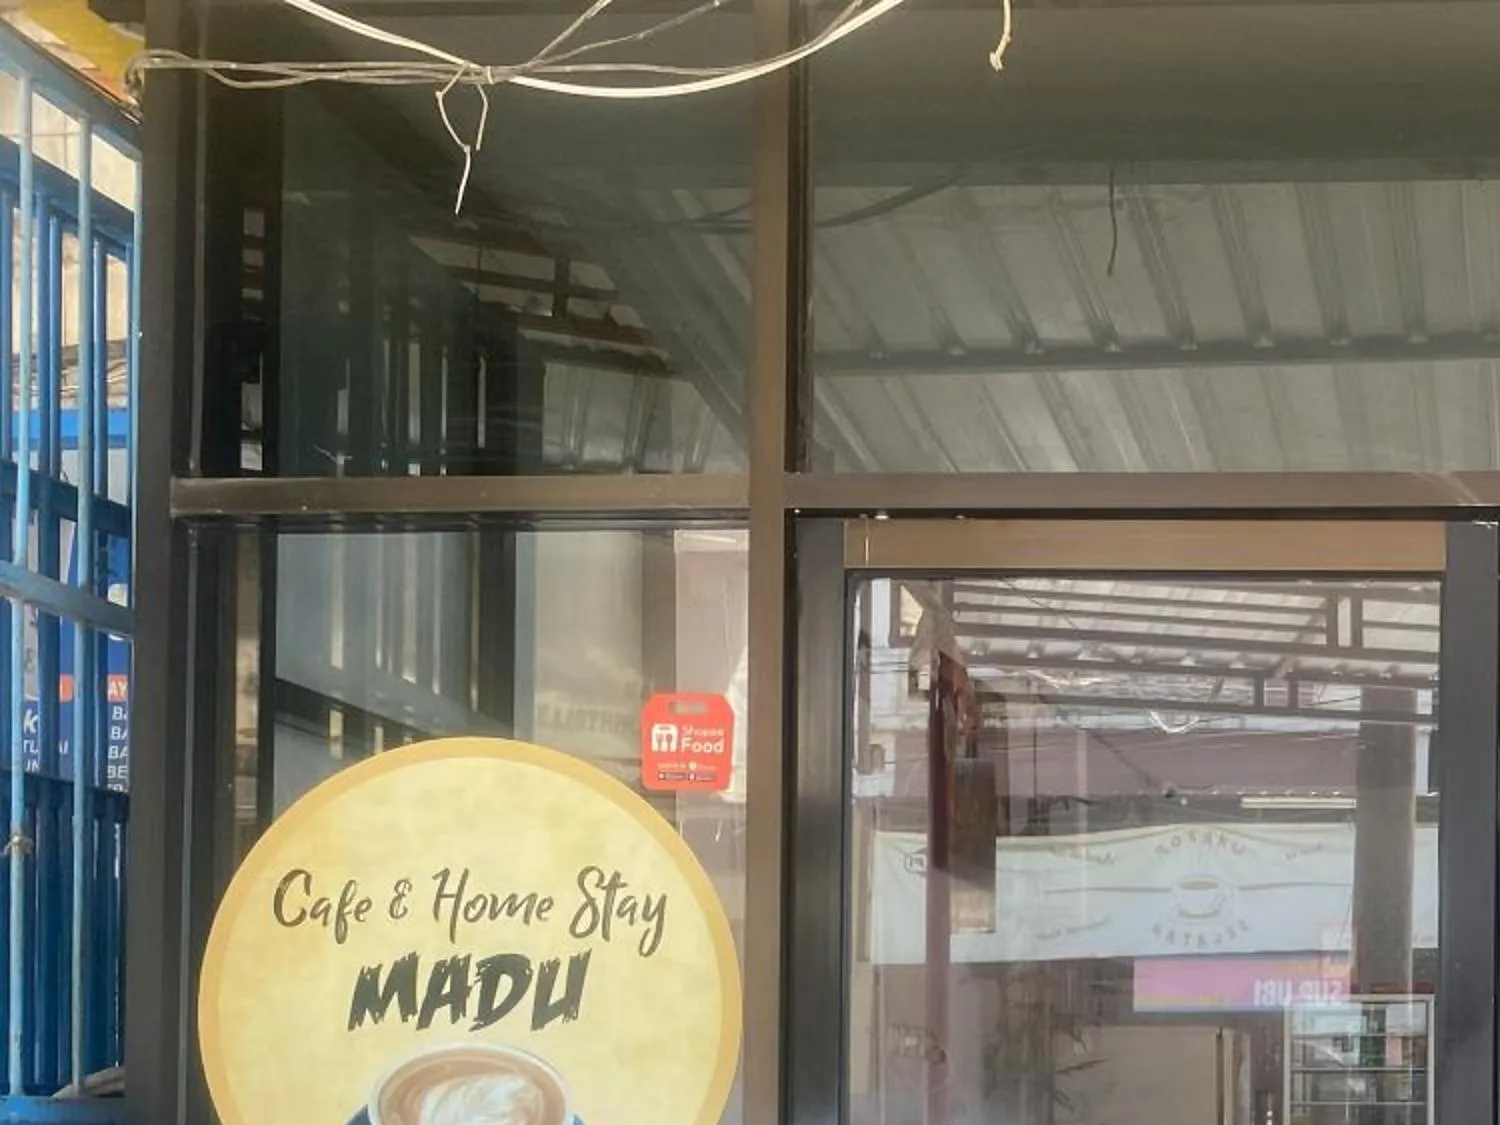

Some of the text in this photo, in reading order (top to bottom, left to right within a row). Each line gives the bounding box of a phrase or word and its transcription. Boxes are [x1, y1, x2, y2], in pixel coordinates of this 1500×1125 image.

[681, 737, 725, 753] Food
[274, 864, 668, 958] Cafe & Home Stay
[347, 950, 592, 1032] MADU
